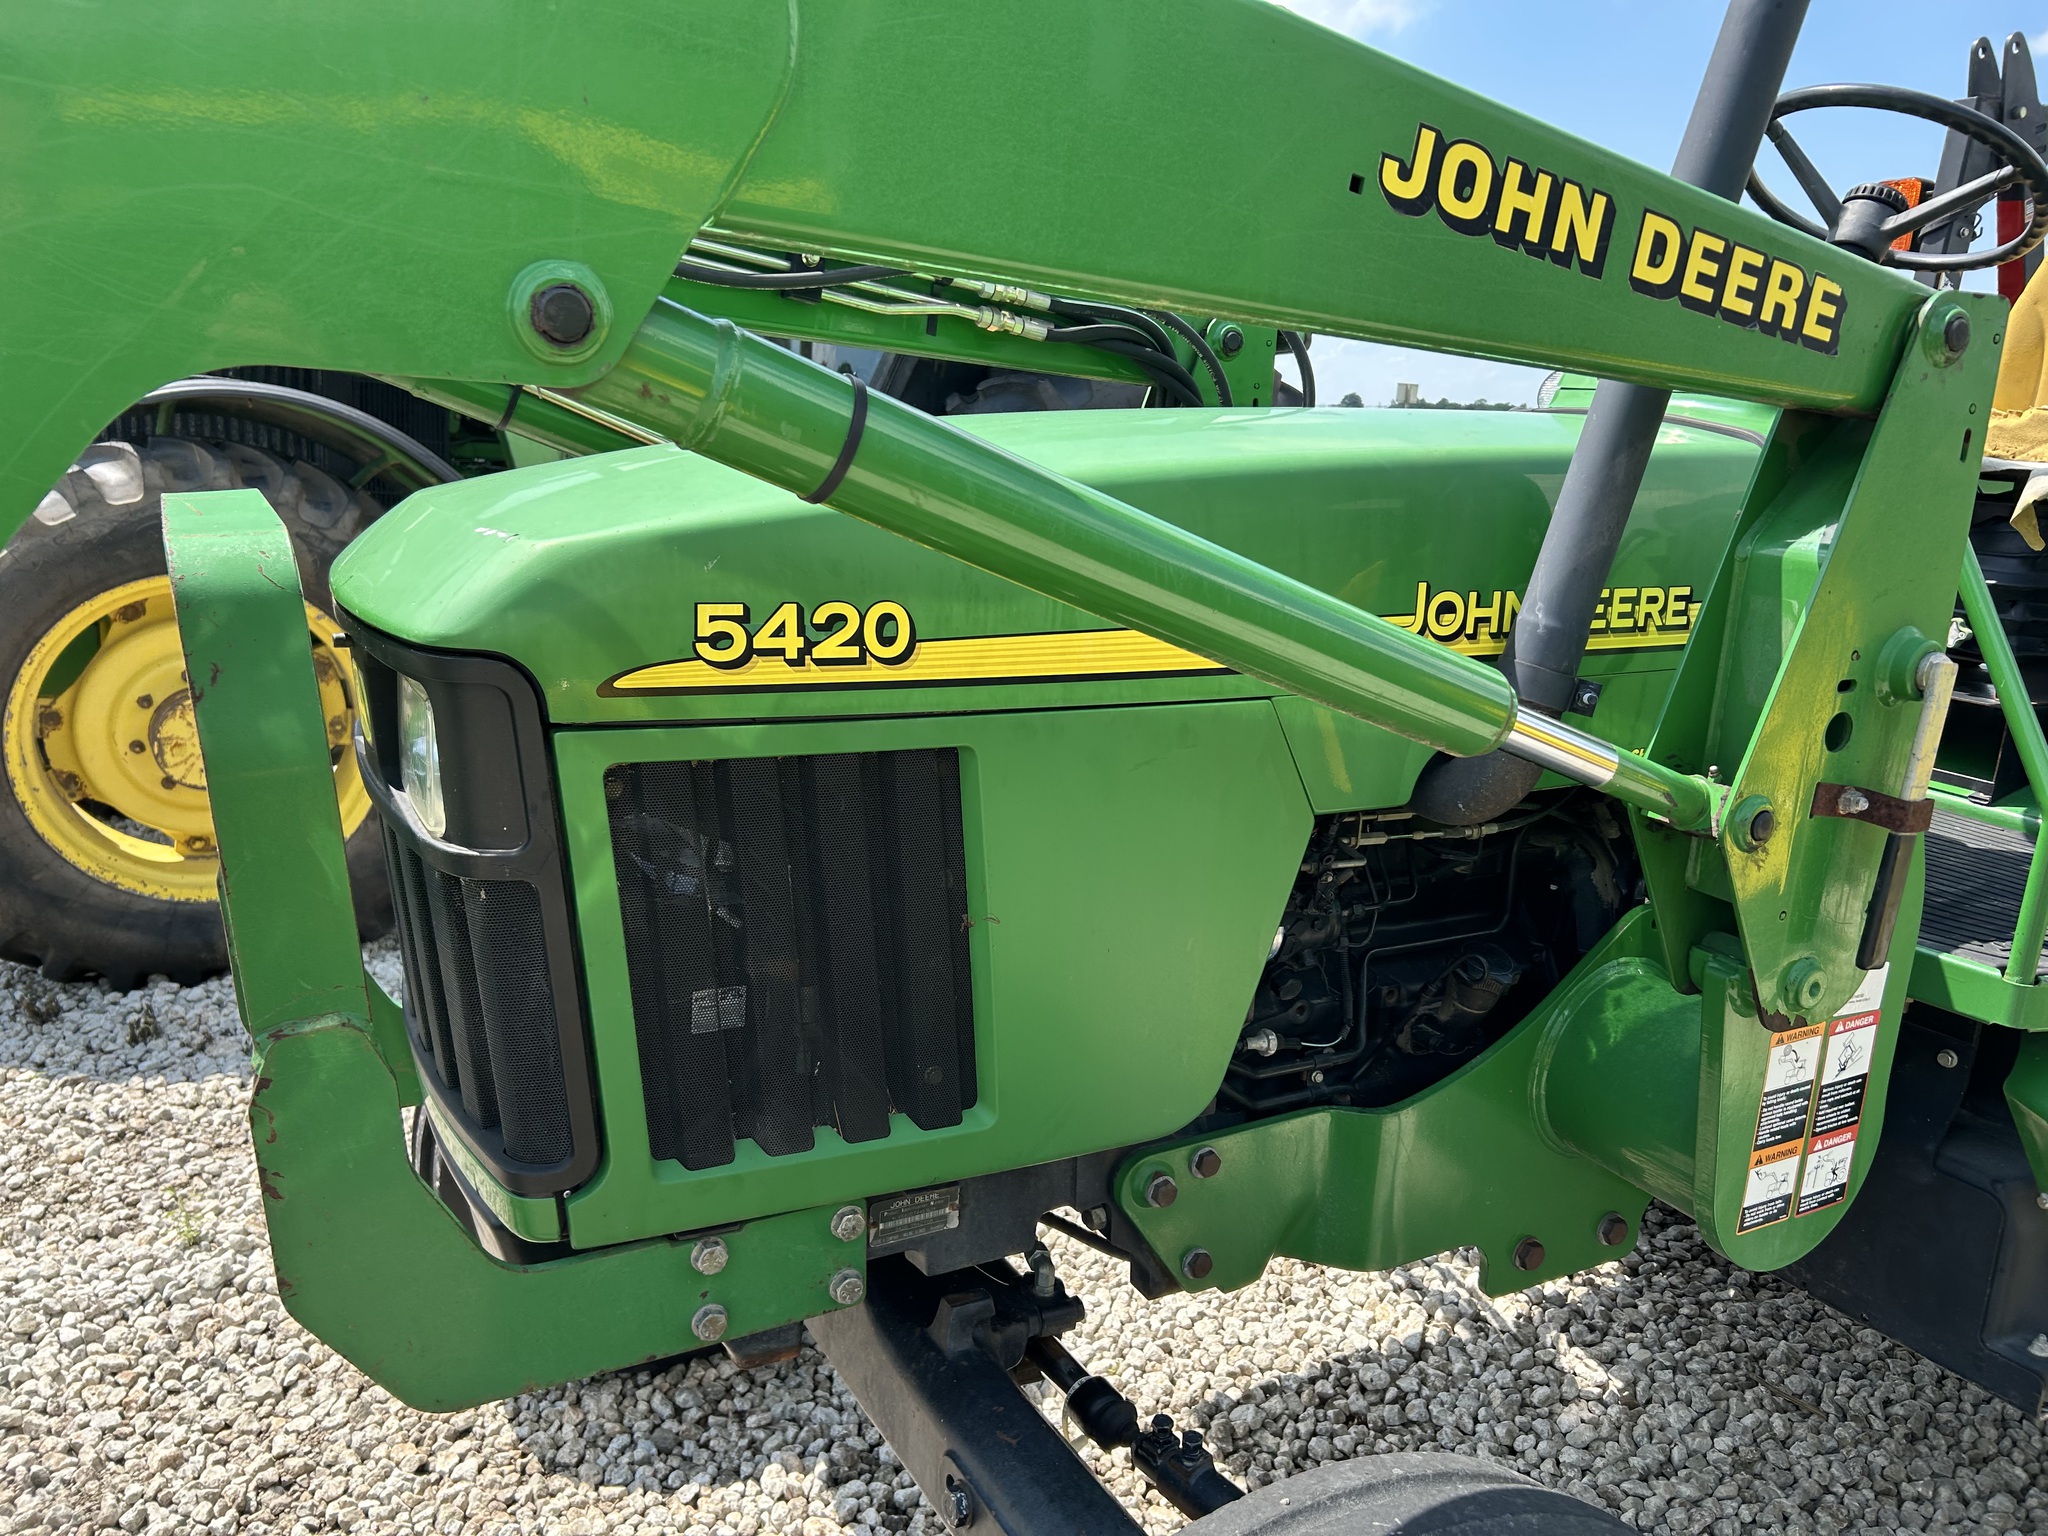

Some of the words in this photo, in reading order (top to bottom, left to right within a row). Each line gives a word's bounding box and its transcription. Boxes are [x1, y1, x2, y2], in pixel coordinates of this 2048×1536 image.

[1380, 125, 1612, 272] JOHN
[1630, 209, 1845, 350] DEERE
[1590, 586, 1692, 632] ERE
[693, 600, 915, 668] 5420
[1845, 1015, 1874, 1029] DANGER
[1786, 1026, 1820, 1042] WARNING
[1823, 1132, 1852, 1148] DANGER
[1765, 1146, 1798, 1162] WARNING
[890, 1198, 911, 1209] JOHN
[914, 1193, 940, 1203] DEERE
